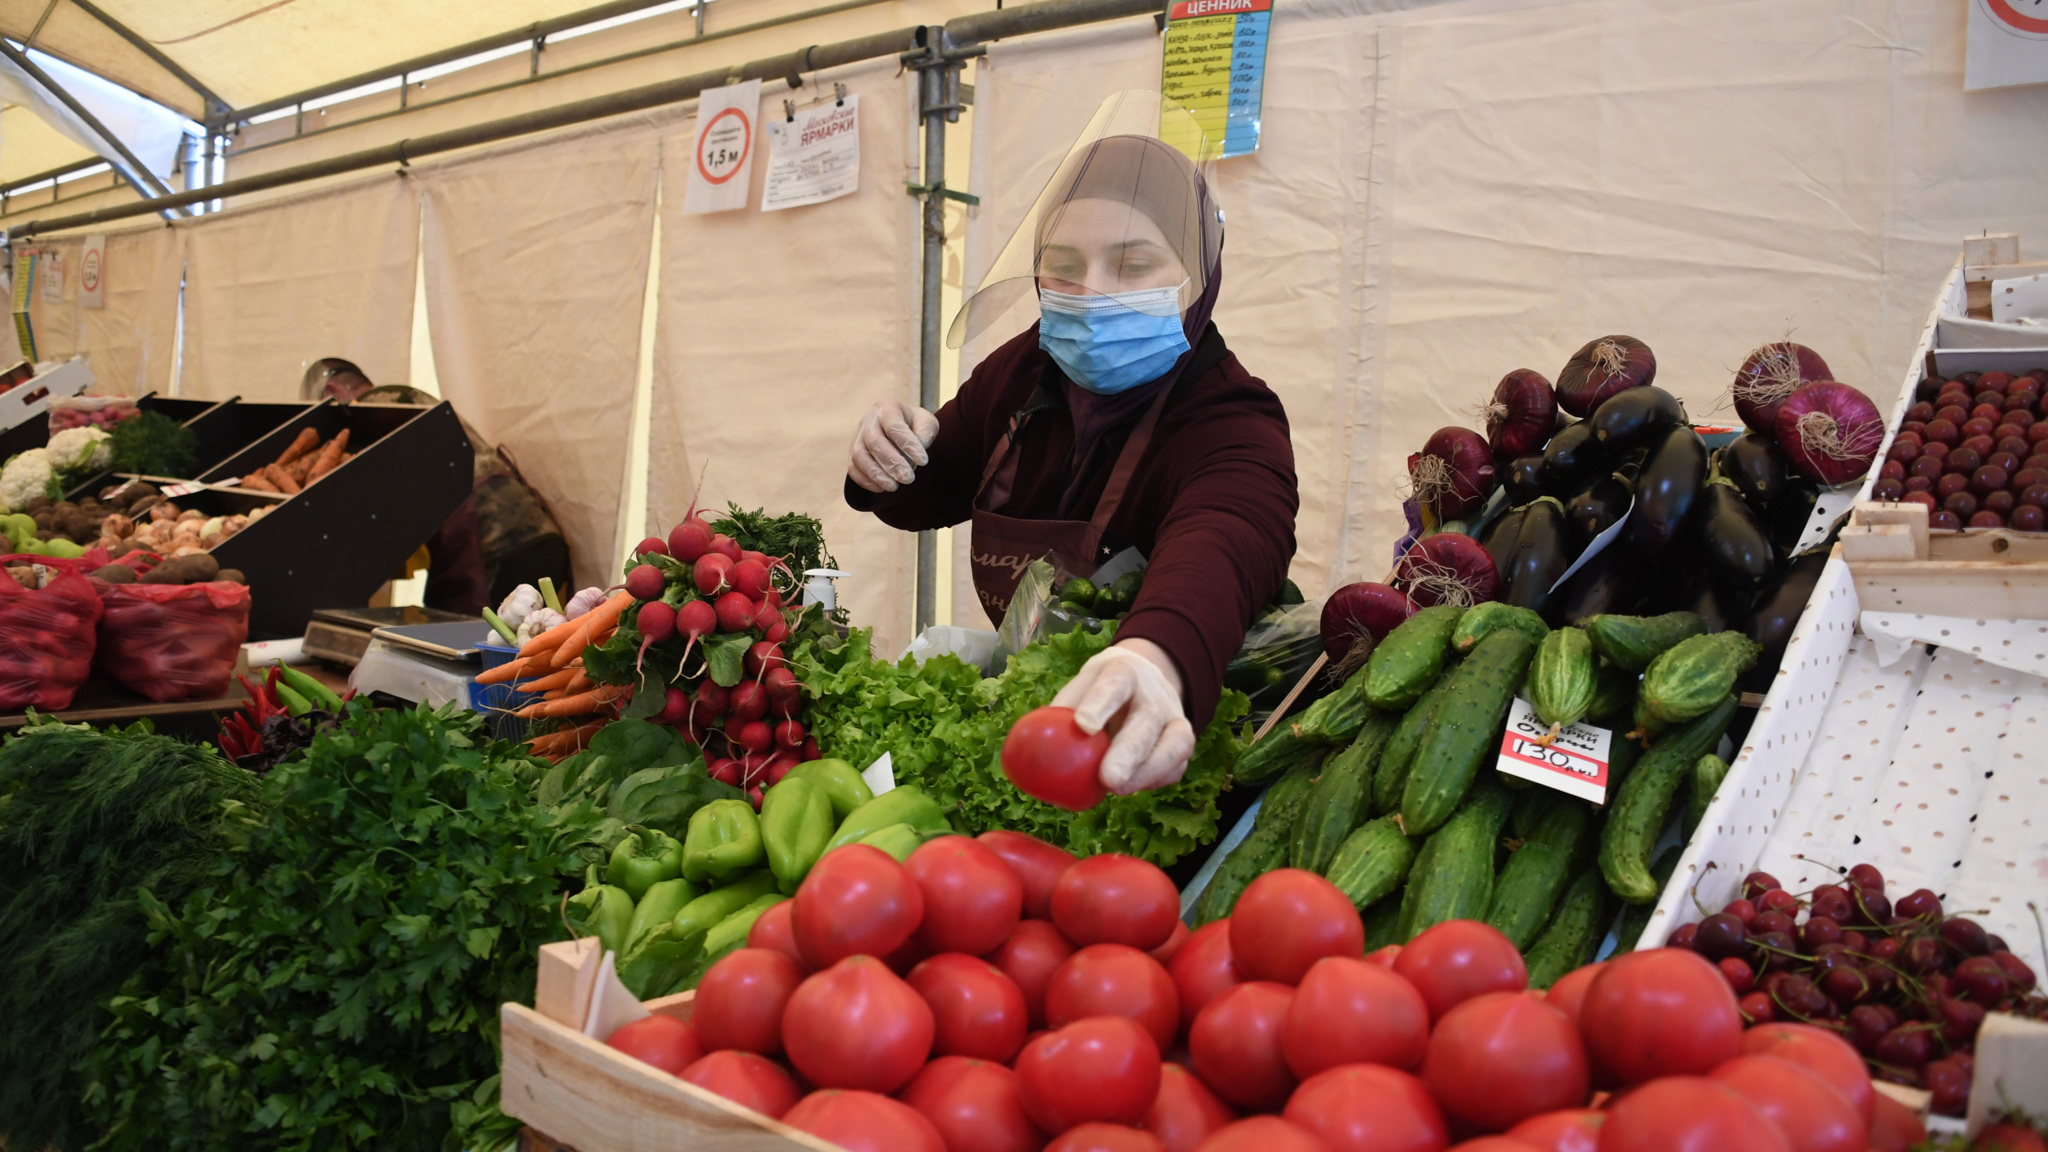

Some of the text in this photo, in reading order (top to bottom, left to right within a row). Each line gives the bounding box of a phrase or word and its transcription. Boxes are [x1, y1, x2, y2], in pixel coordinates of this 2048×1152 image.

[1187, 0, 1252, 15] ЦЕННИК
[801, 117, 854, 147] ЯРМАРКИ
[707, 149, 726, 169] 1,5
